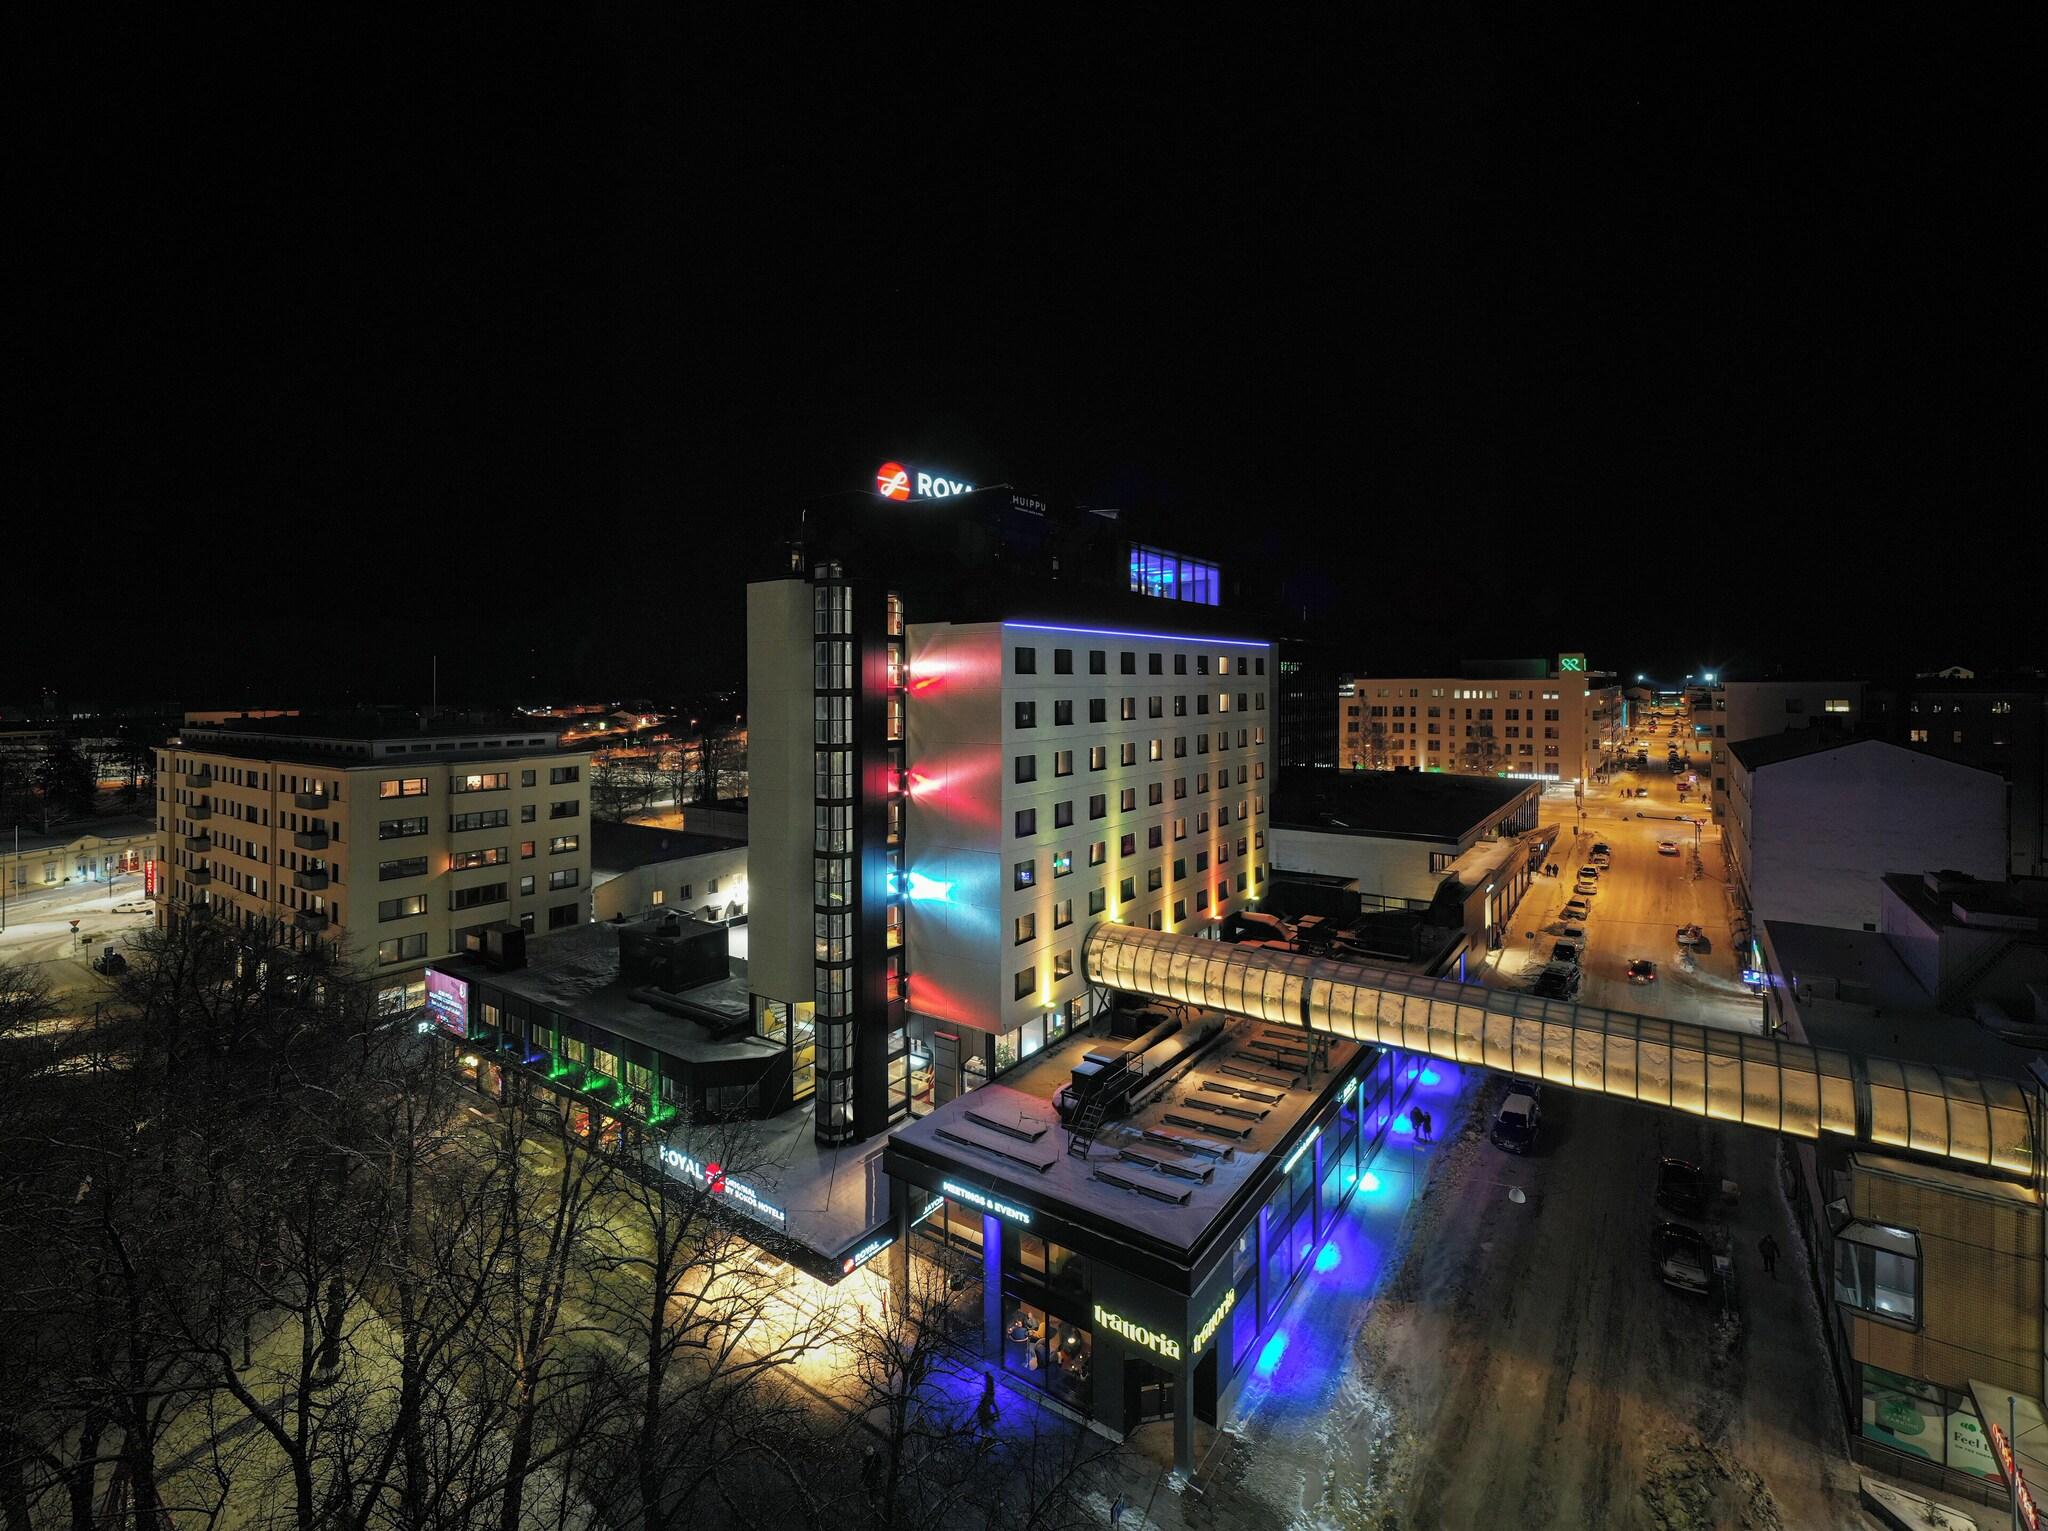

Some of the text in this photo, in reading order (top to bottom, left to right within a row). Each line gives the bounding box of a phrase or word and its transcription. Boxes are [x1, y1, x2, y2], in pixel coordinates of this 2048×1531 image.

[1012, 495, 1046, 512] HUIPPU
[758, 1201, 785, 1221] HOTELS
[943, 1181, 986, 1206] MEETINGS
[994, 1202, 1030, 1224] EVENTS
[854, 1241, 880, 1263] ROYAL
